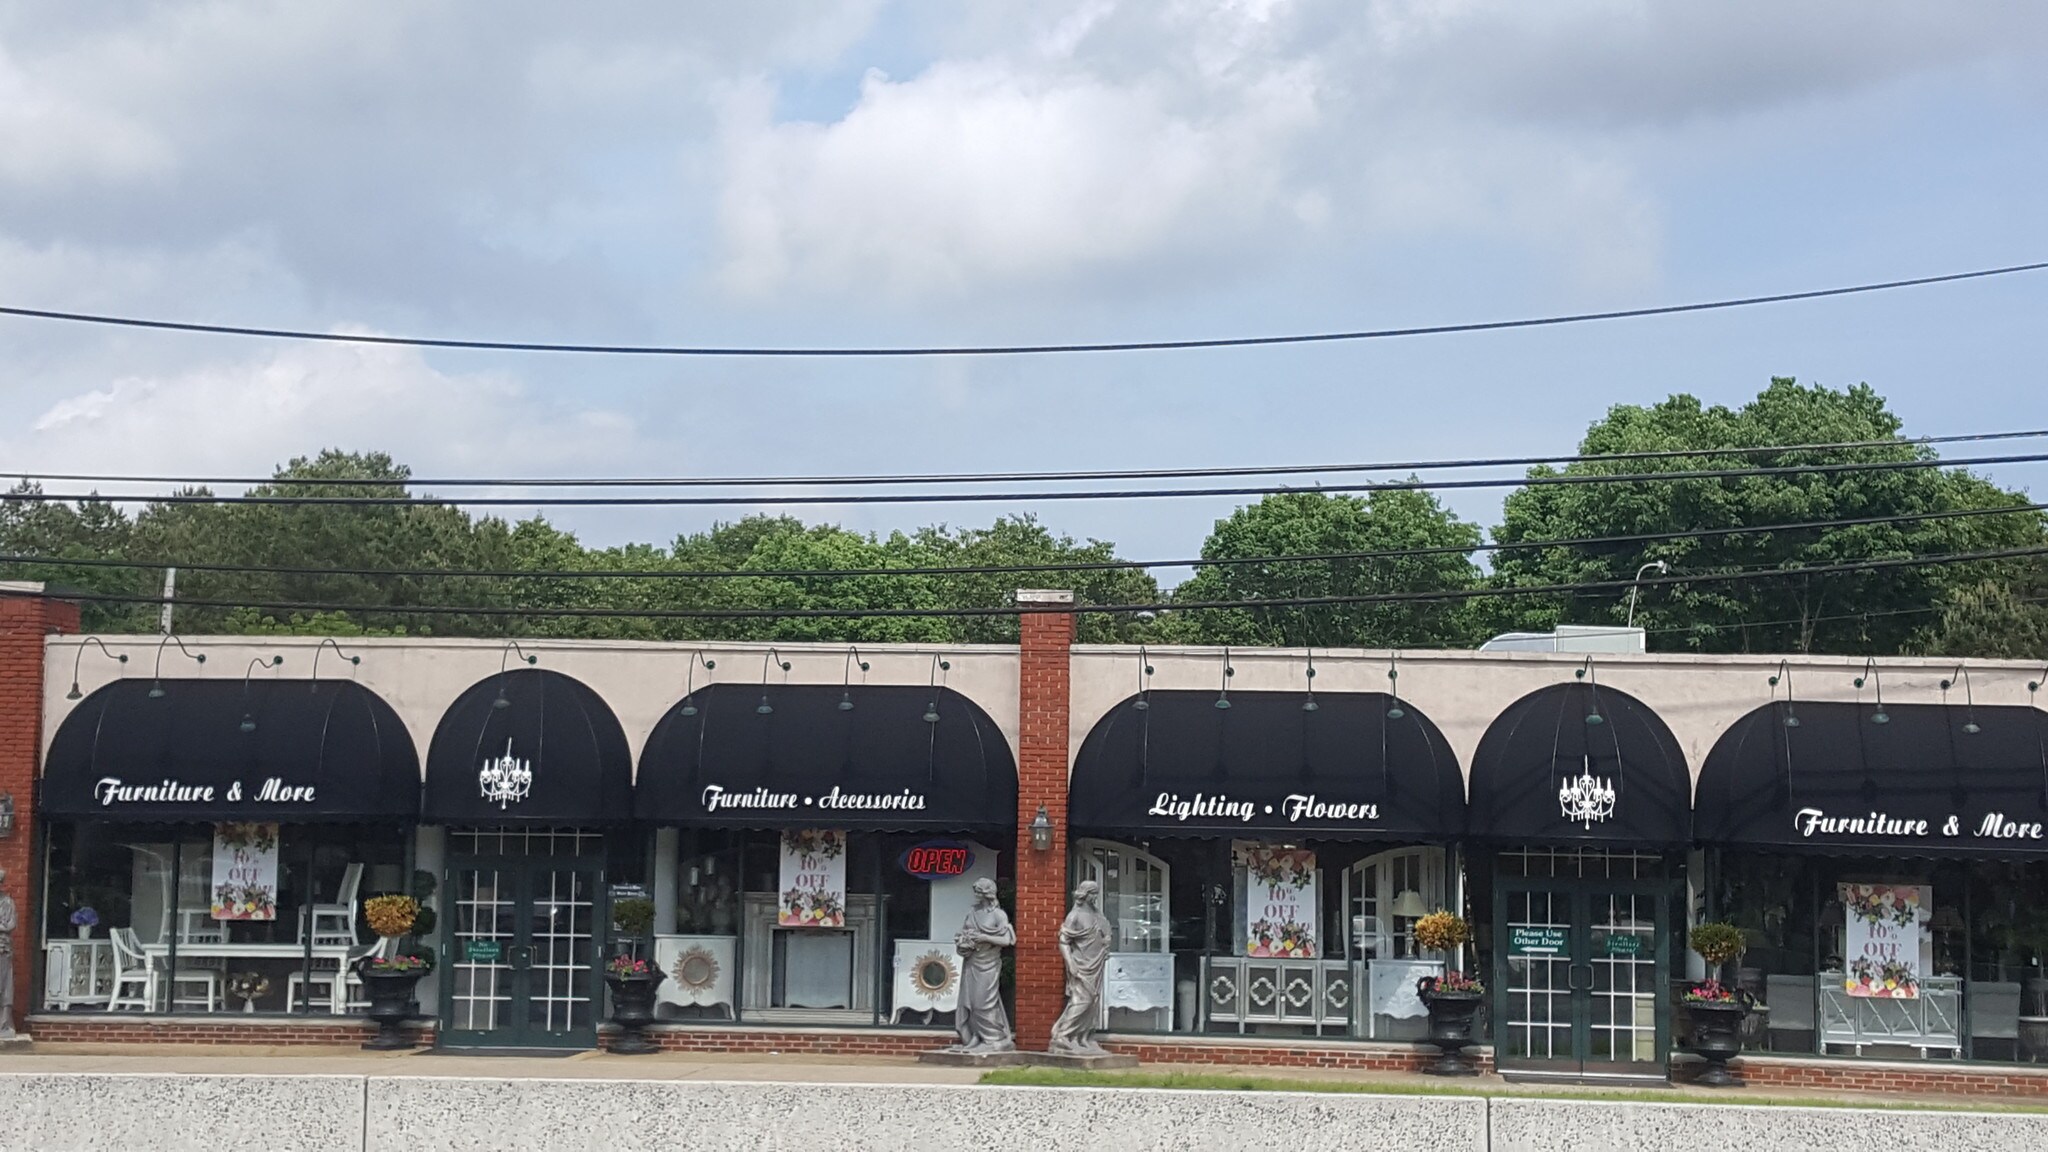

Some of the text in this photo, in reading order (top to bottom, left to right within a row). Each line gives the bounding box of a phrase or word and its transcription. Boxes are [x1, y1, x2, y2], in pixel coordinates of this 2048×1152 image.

[95, 777, 316, 805] Furniture & More
[702, 784, 926, 812] Furniture Accessories
[1148, 792, 1380, 822] Lighting Flowers
[1795, 808, 2044, 839] Furniture & More
[908, 847, 966, 874] OPEN
[795, 874, 830, 887] OFF
[1264, 904, 1299, 918] OFF
[1513, 937, 1564, 946] Other Door
[1515, 928, 1562, 938] Please Use
[1863, 942, 1902, 957] OFF
